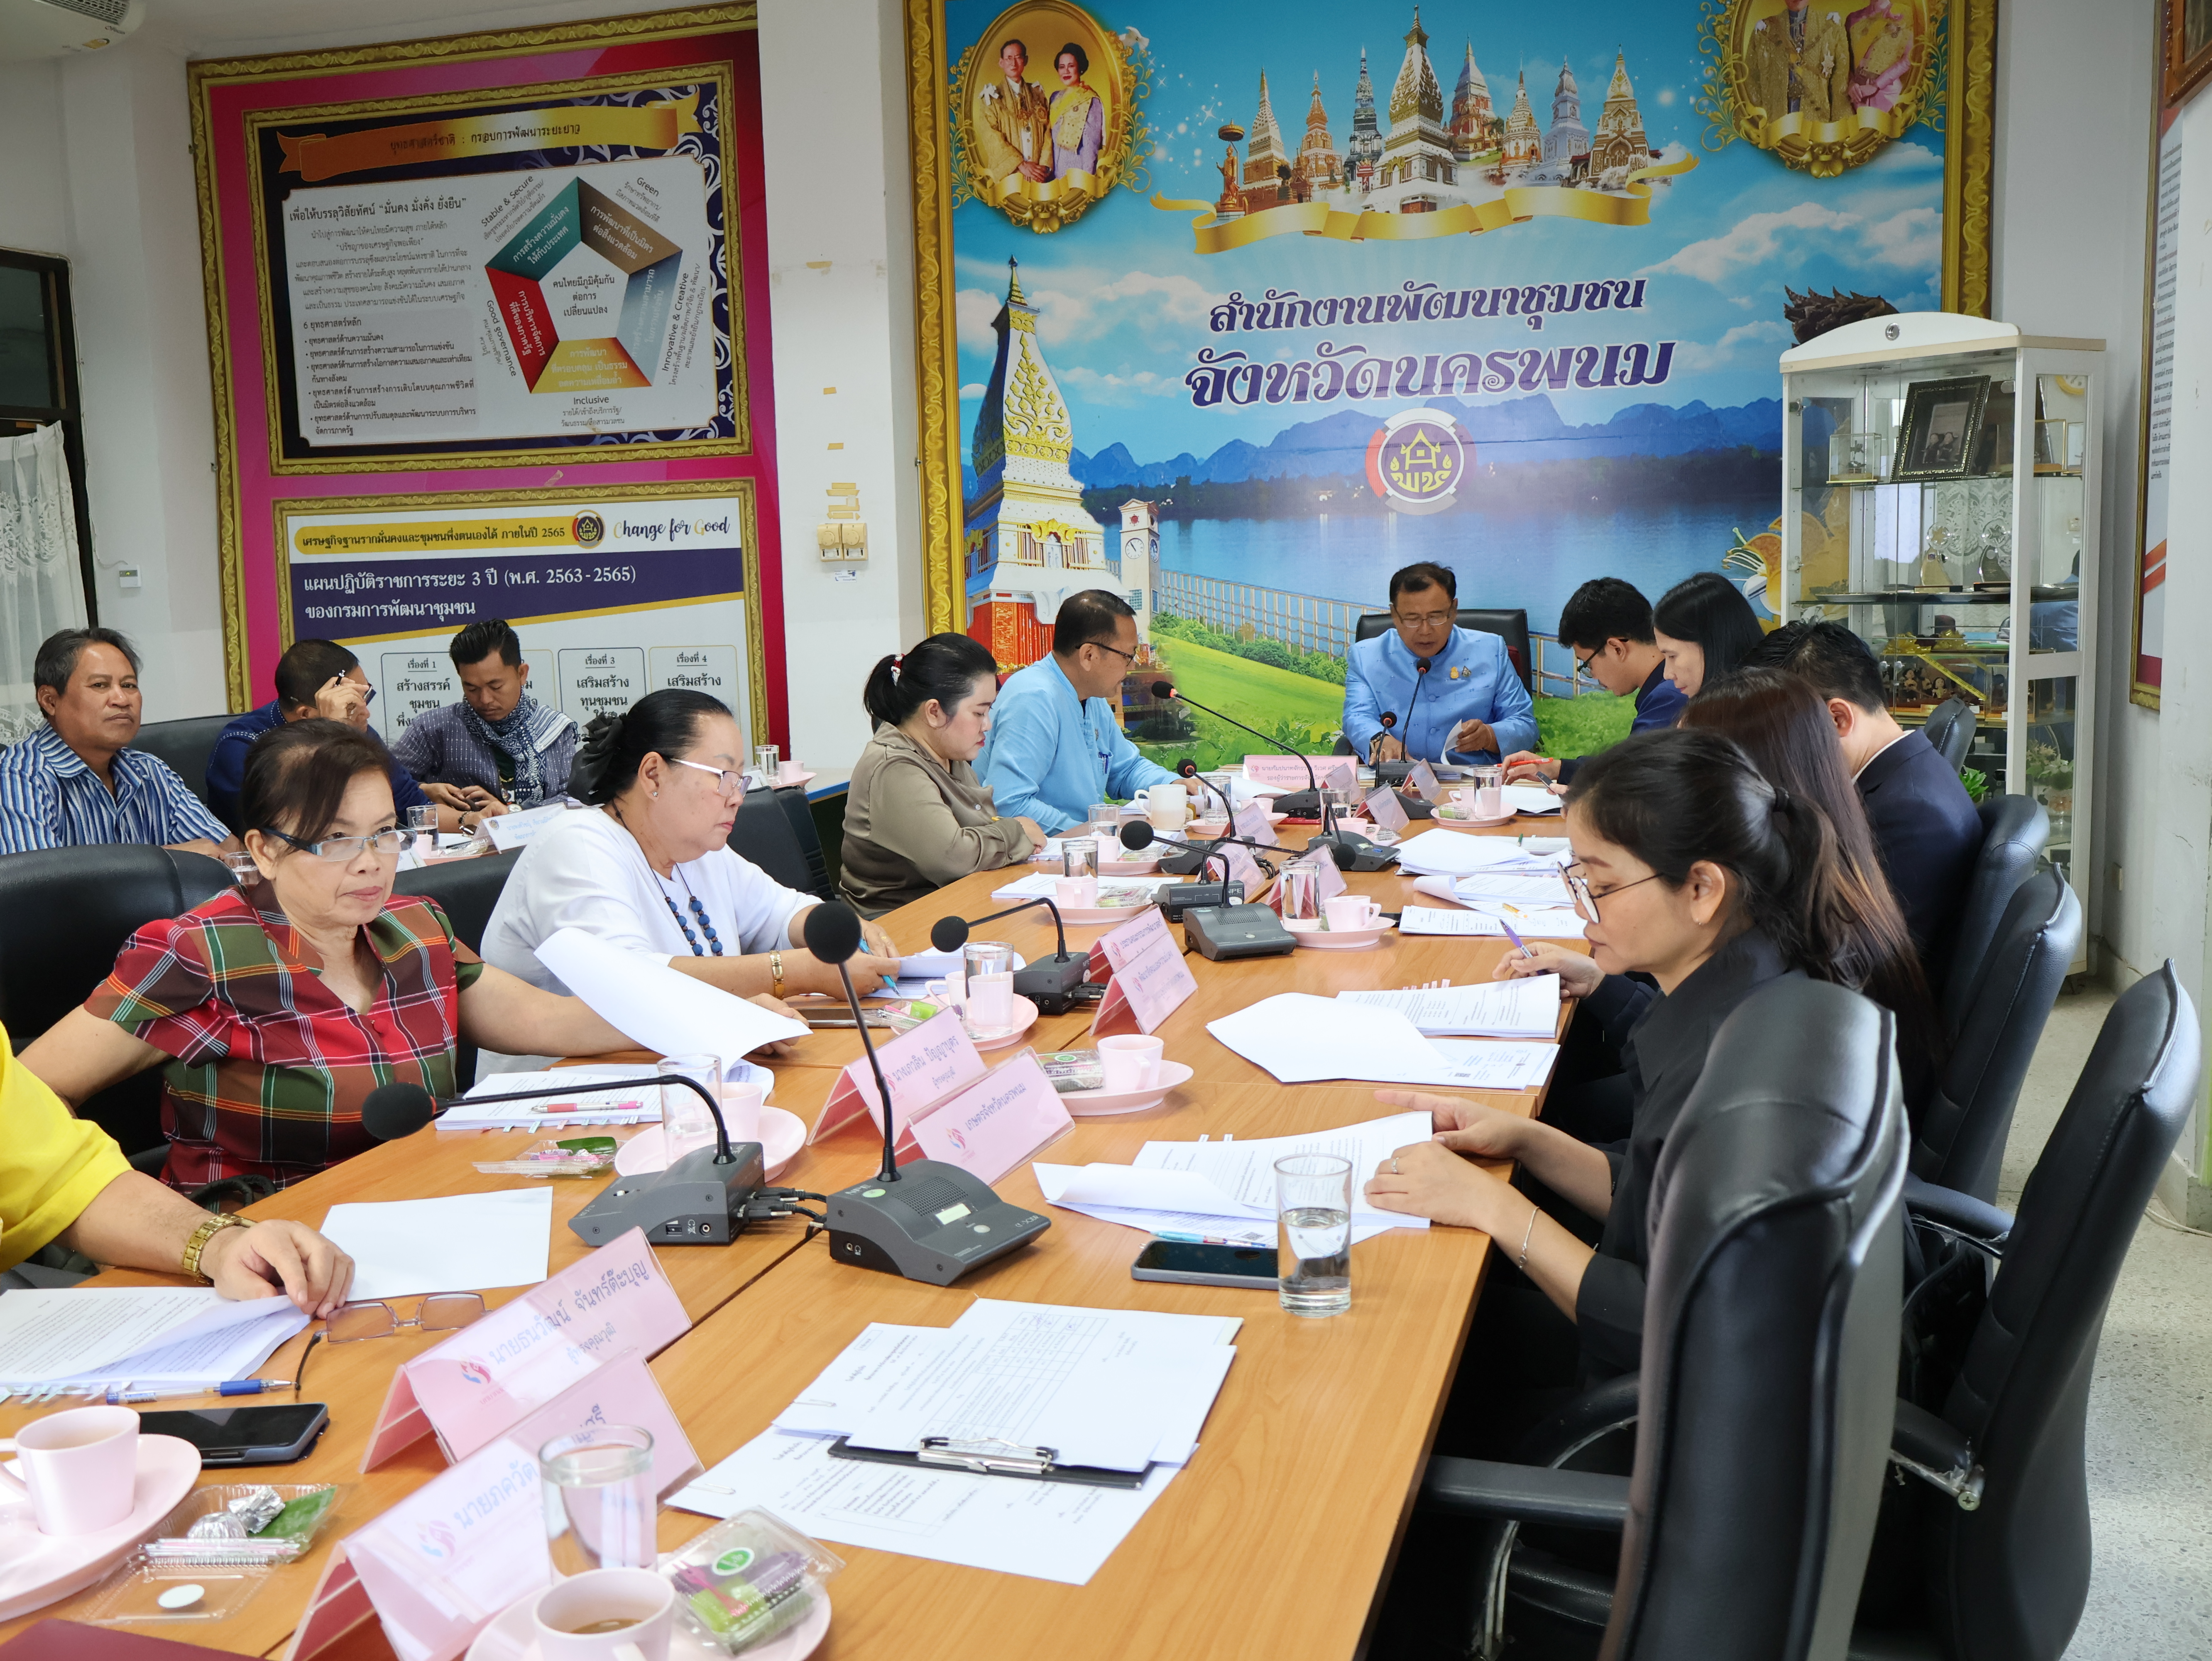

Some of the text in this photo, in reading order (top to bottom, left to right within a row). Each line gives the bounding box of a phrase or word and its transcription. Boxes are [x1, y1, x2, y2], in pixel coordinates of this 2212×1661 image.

[471, 123, 580, 144] กรอบการพัฒนาระยะยาว
[637, 177, 659, 196] Green
[290, 203, 375, 222] เพื่อให้บรรลุวิสัยทัศน์
[411, 197, 434, 212] มั่งคั่ง
[482, 205, 503, 227] Stable
[510, 176, 533, 199] Secure
[513, 206, 570, 262] การสร้างความมั่นคง
[590, 206, 654, 254] การพัฒนาที่เป็นมิตร
[593, 224, 638, 260] ต่อสิ่งแวดล้อม
[527, 225, 569, 264] ให้กับประเทศ
[553, 274, 614, 289] คนไทยมีภูมิคุ้มกัน
[573, 291, 597, 301] ต่อการ
[1209, 279, 1647, 331] สำนักงานพัฒนาชุมชน
[564, 304, 607, 316] เปลี่ยนแปลง
[662, 324, 678, 371] Innovative
[675, 273, 688, 311] Creative
[310, 317, 361, 331] ยุทธศาสตร์หลัก
[509, 301, 533, 356] ที่ดีของภาครัฐ
[519, 290, 546, 356] การบริหารจัดการ
[309, 334, 383, 345] ยุทธศาสตร์ด้านความมั่นคง
[487, 300, 516, 377] Good governance
[1184, 341, 1677, 409] จังหวัดนครพนม
[573, 396, 609, 405] Inclusive
[303, 525, 565, 549] เศรษฐกิจฐานรากมั่นคงและชุมชนพึ่งตนเองได้ ภายในปี 2565
[614, 516, 730, 541] Change for Good
[304, 571, 466, 594] แผนปฏิบัติราชการระยะ
[472, 571, 481, 586] 3
[485, 568, 497, 586] ปี
[504, 568, 540, 588] (พ.ศ.
[305, 599, 476, 622] ของกรมการพัฒนาชุมชน
[408, 657, 428, 669] เรื่องที่
[585, 654, 607, 665] เรื่องที่
[676, 652, 699, 663] เรื่องที่
[396, 678, 450, 691] สร้างสรรค์
[577, 674, 629, 688] เสริมสร้าง
[667, 672, 722, 687] เสริมสร้าง
[409, 698, 440, 713] ชุมชน
[580, 696, 628, 711] ทุนชุมชน
[892, 1036, 959, 1081] นางเกวลิน ปัญญาบุตร
[965, 1082, 1027, 1131] เกษตรจังหวัดนครพนม
[489, 1299, 571, 1365] นายธนวัฒน์
[566, 1322, 617, 1365] ผู้ทรงคุณวุฒิ
